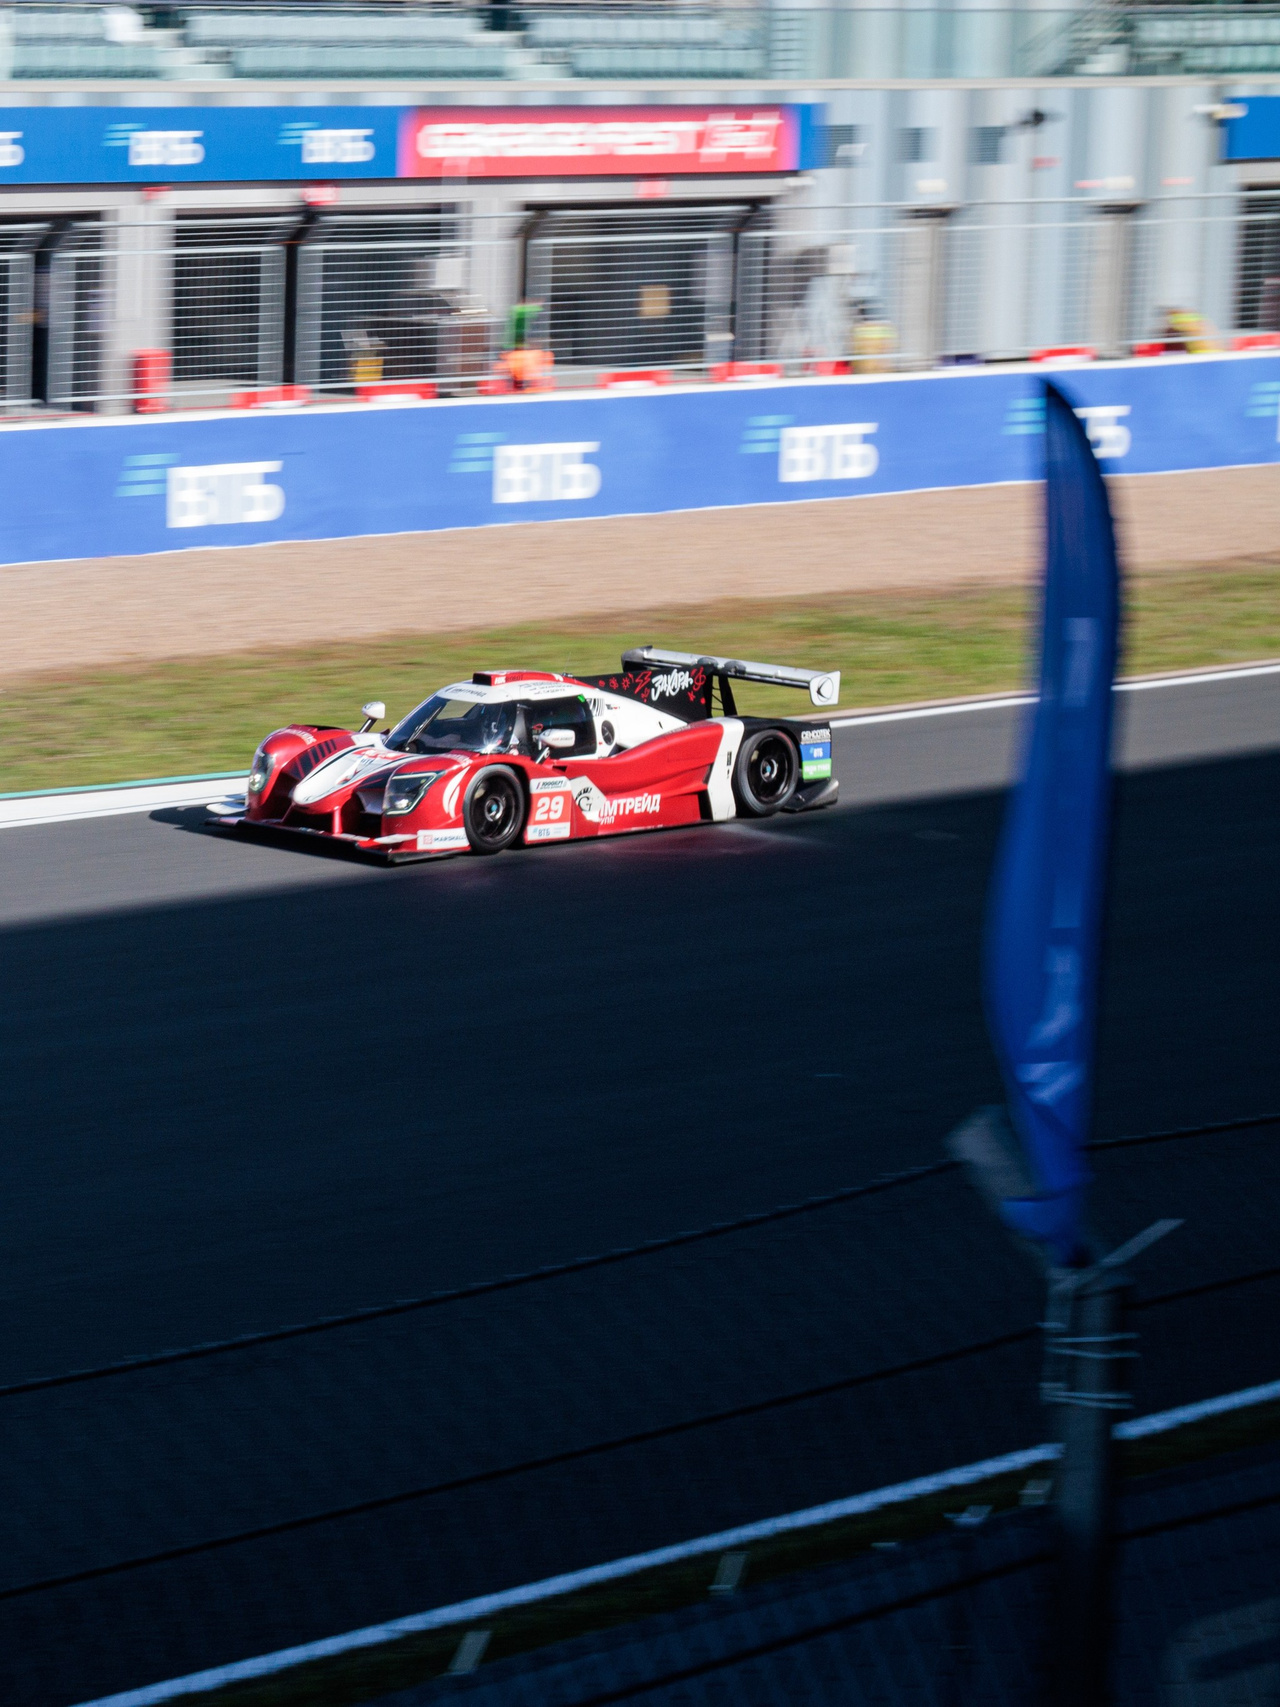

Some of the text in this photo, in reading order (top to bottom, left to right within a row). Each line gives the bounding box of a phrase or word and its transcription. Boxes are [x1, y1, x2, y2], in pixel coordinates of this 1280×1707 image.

[492, 441, 601, 503] ВТБ
[778, 422, 879, 482] ВТБ
[166, 460, 285, 529] ВТБ
[535, 795, 564, 821] 29
